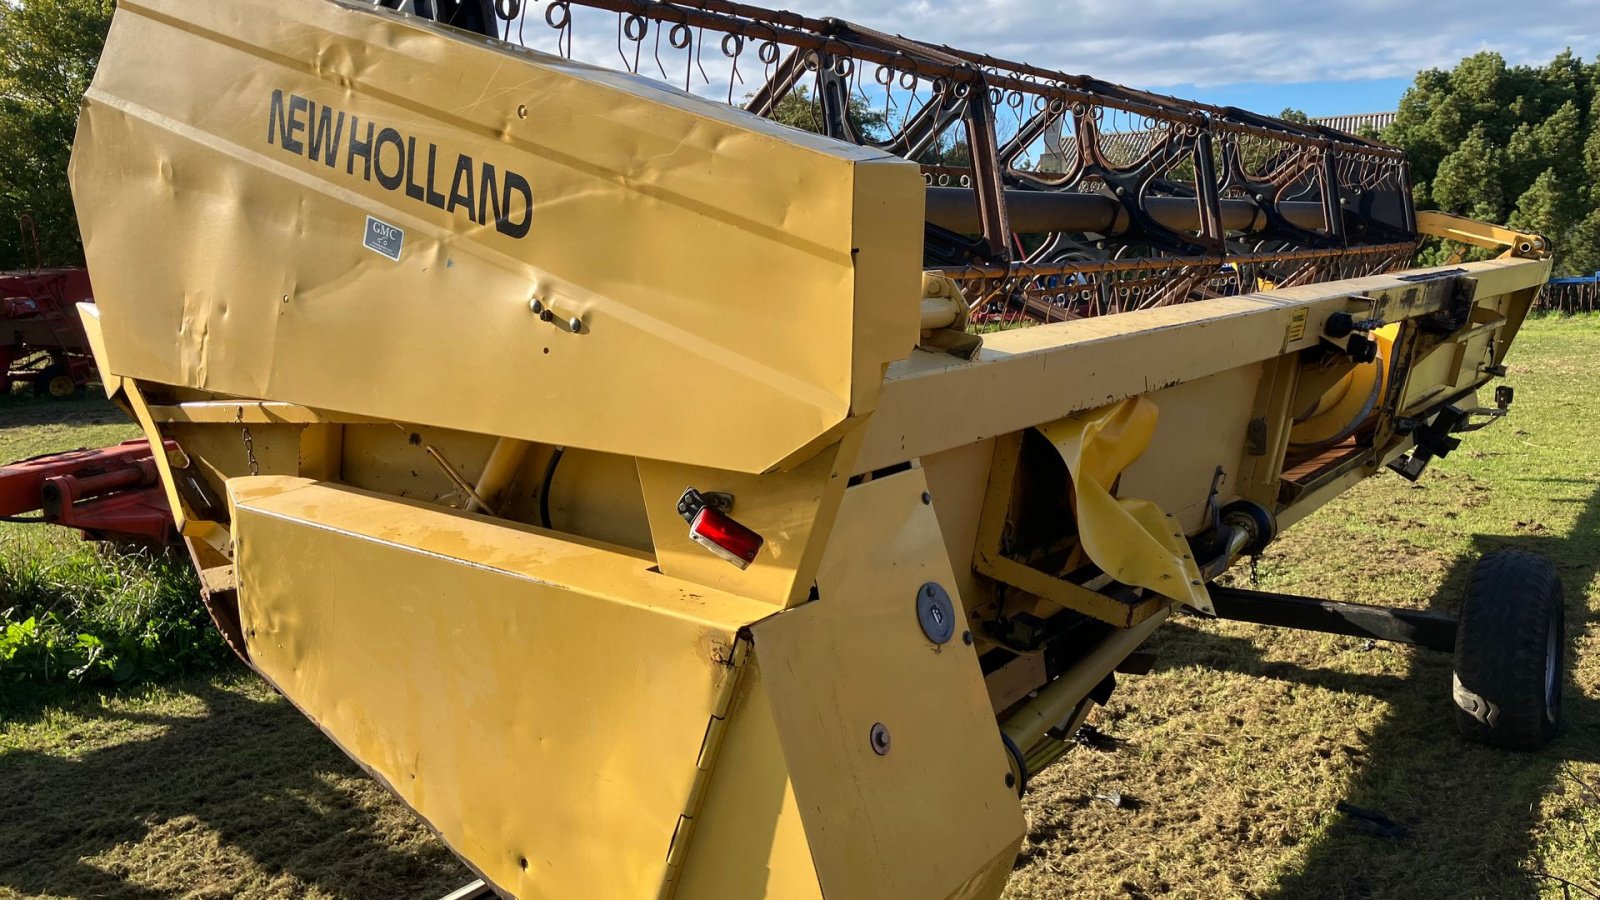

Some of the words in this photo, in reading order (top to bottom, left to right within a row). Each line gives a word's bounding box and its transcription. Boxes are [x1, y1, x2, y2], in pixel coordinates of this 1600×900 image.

[268, 89, 345, 168] NEW
[347, 116, 533, 239] HOLLAND
[373, 222, 397, 241] GMC
